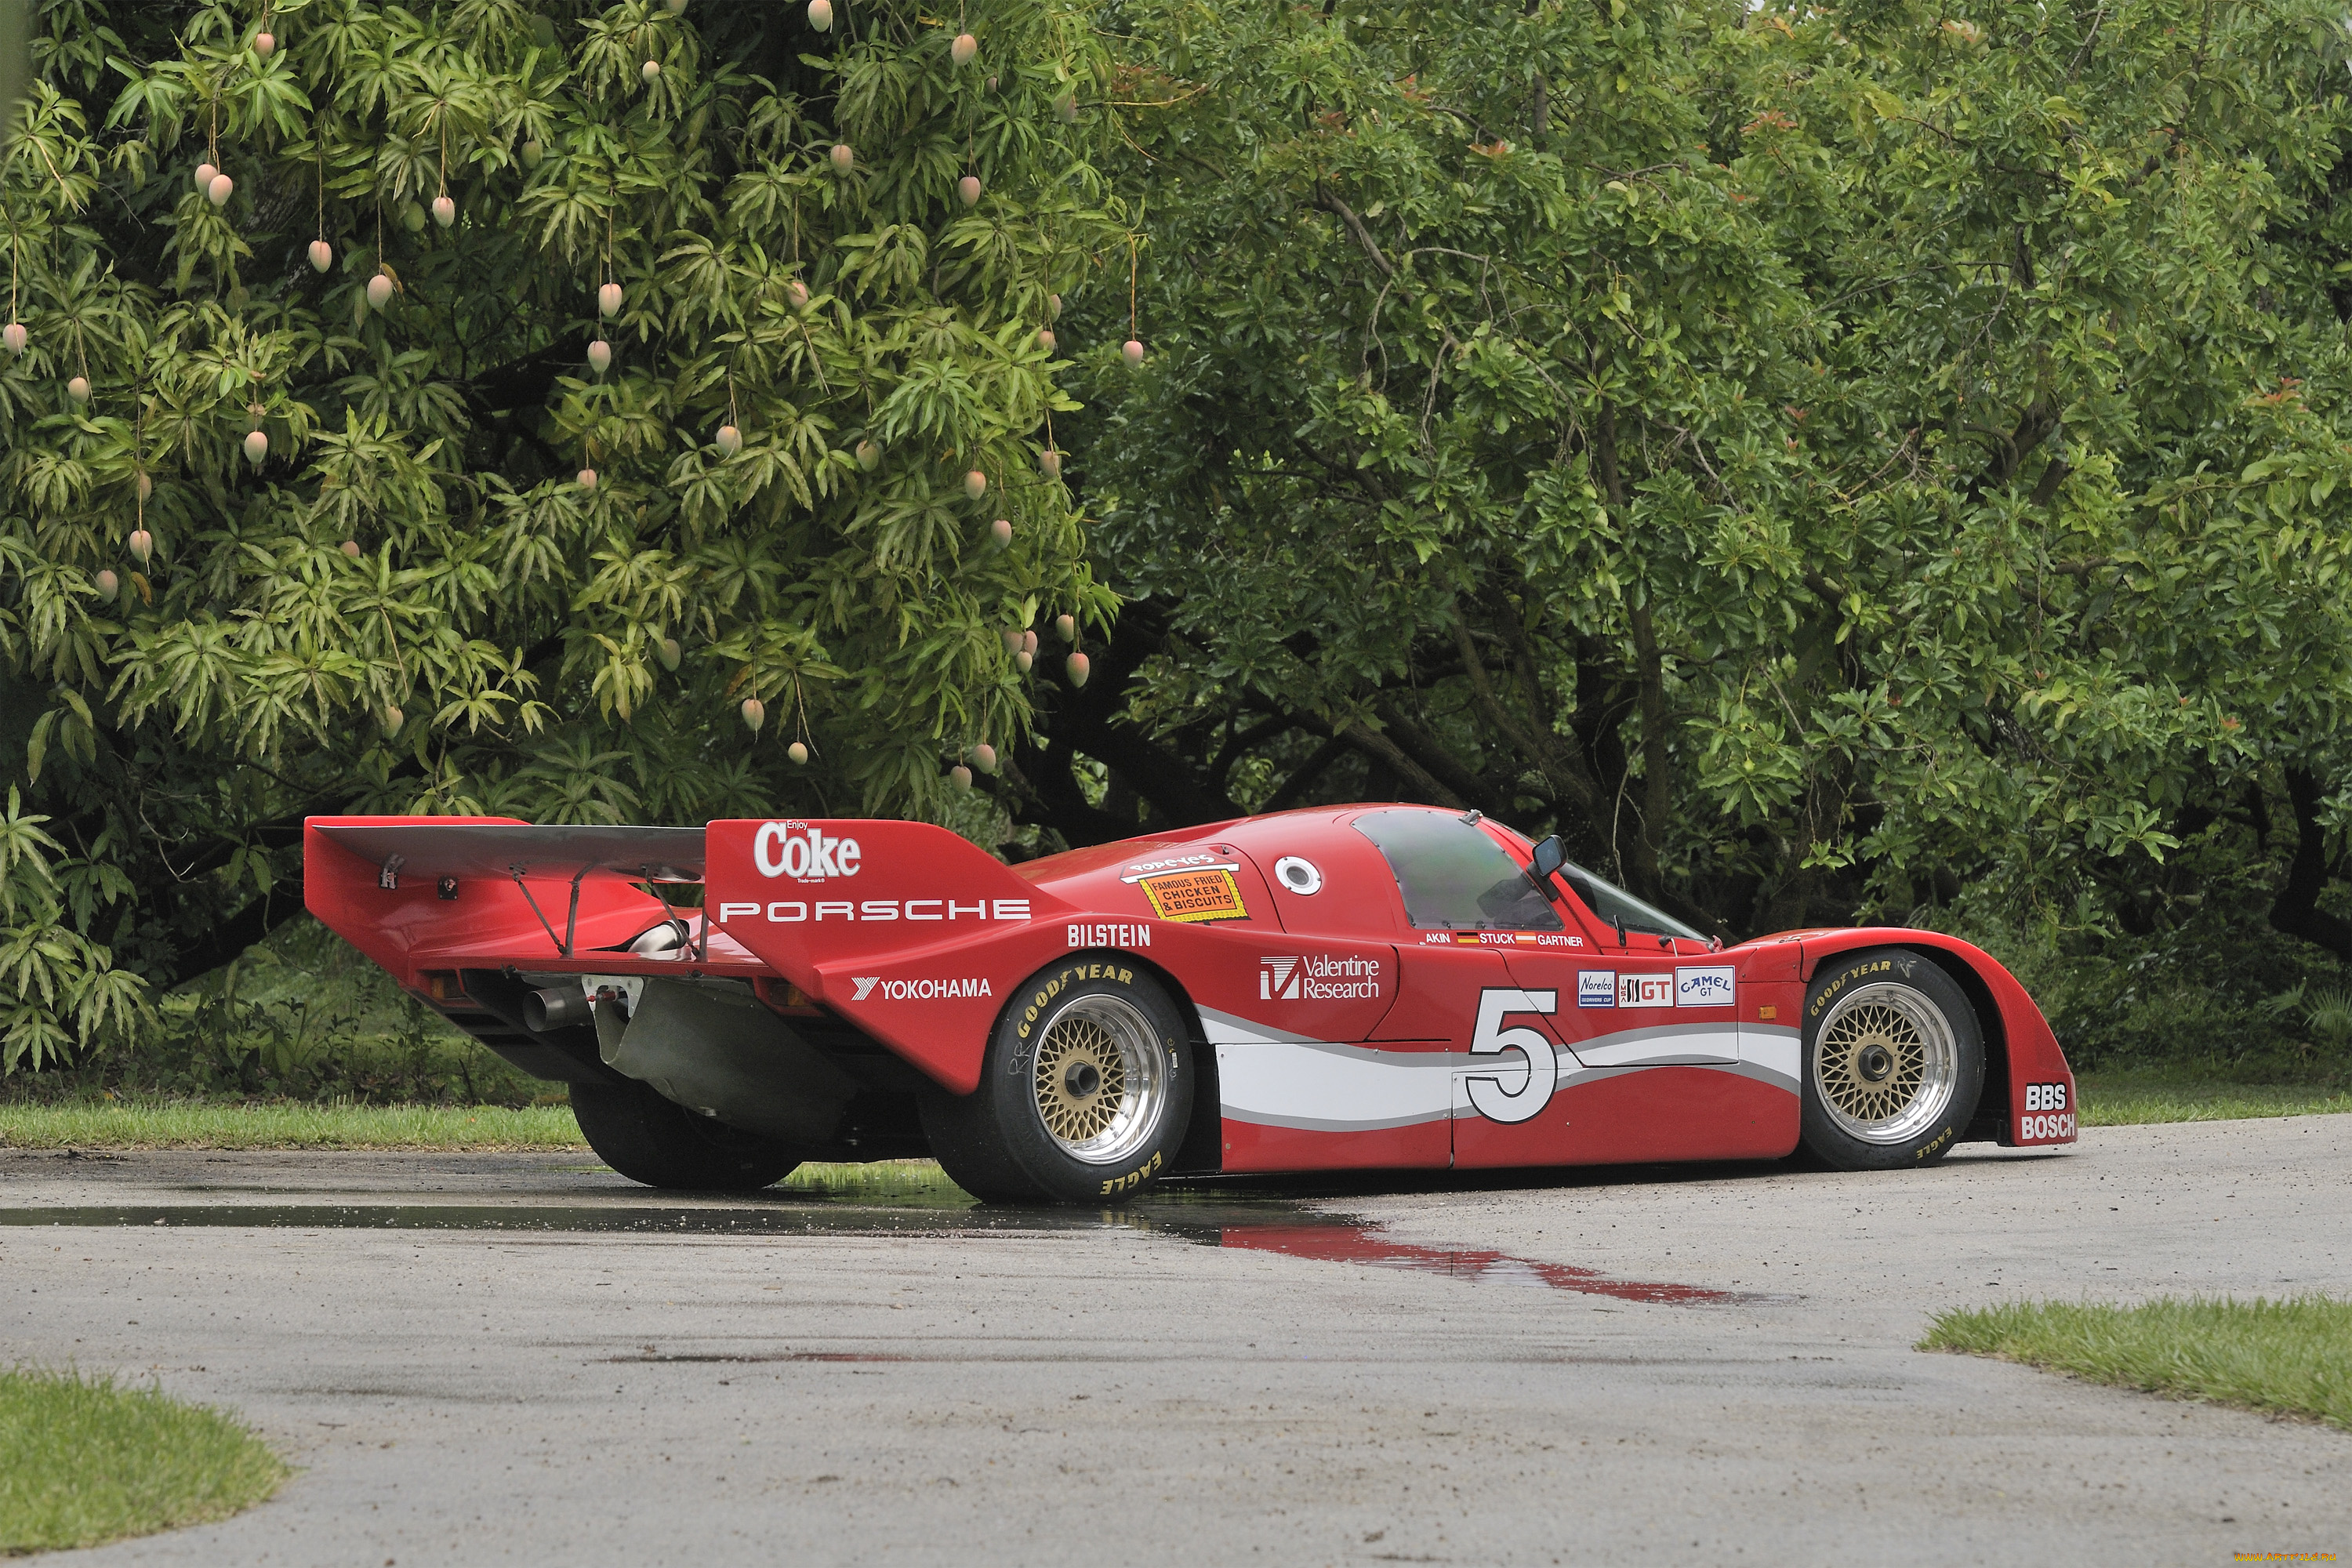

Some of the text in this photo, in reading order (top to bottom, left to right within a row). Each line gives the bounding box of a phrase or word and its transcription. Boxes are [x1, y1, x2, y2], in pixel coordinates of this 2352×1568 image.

[786, 820, 808, 830] Enjoy
[753, 821, 862, 878] Coke
[1152, 875, 1222, 891] FAMOUS FRIED
[1163, 885, 1221, 900] CHICKEN
[720, 899, 1032, 923] PORSCHE
[1163, 895, 1232, 911] & BISCUITS
[1068, 924, 1150, 947] BILSTEIN
[1426, 933, 1450, 943] AKIN
[1479, 933, 1515, 944] STUCK
[1537, 935, 1584, 947] GARTNER
[1303, 954, 1380, 977] Valentine
[880, 978, 993, 1000] YOKOHAMA
[1304, 976, 1379, 999] Research
[1581, 975, 1612, 993] Norelco
[1642, 981, 1671, 1000] GT
[1680, 975, 1731, 993] CAMEL
[1700, 987, 1712, 996] GT
[1465, 986, 1559, 1125] 5
[2025, 1083, 2067, 1111] BBS
[2021, 1113, 2075, 1140] BOSCH
[1916, 1126, 1953, 1160] EAGLE
[1099, 1150, 1163, 1195] EAGLE
